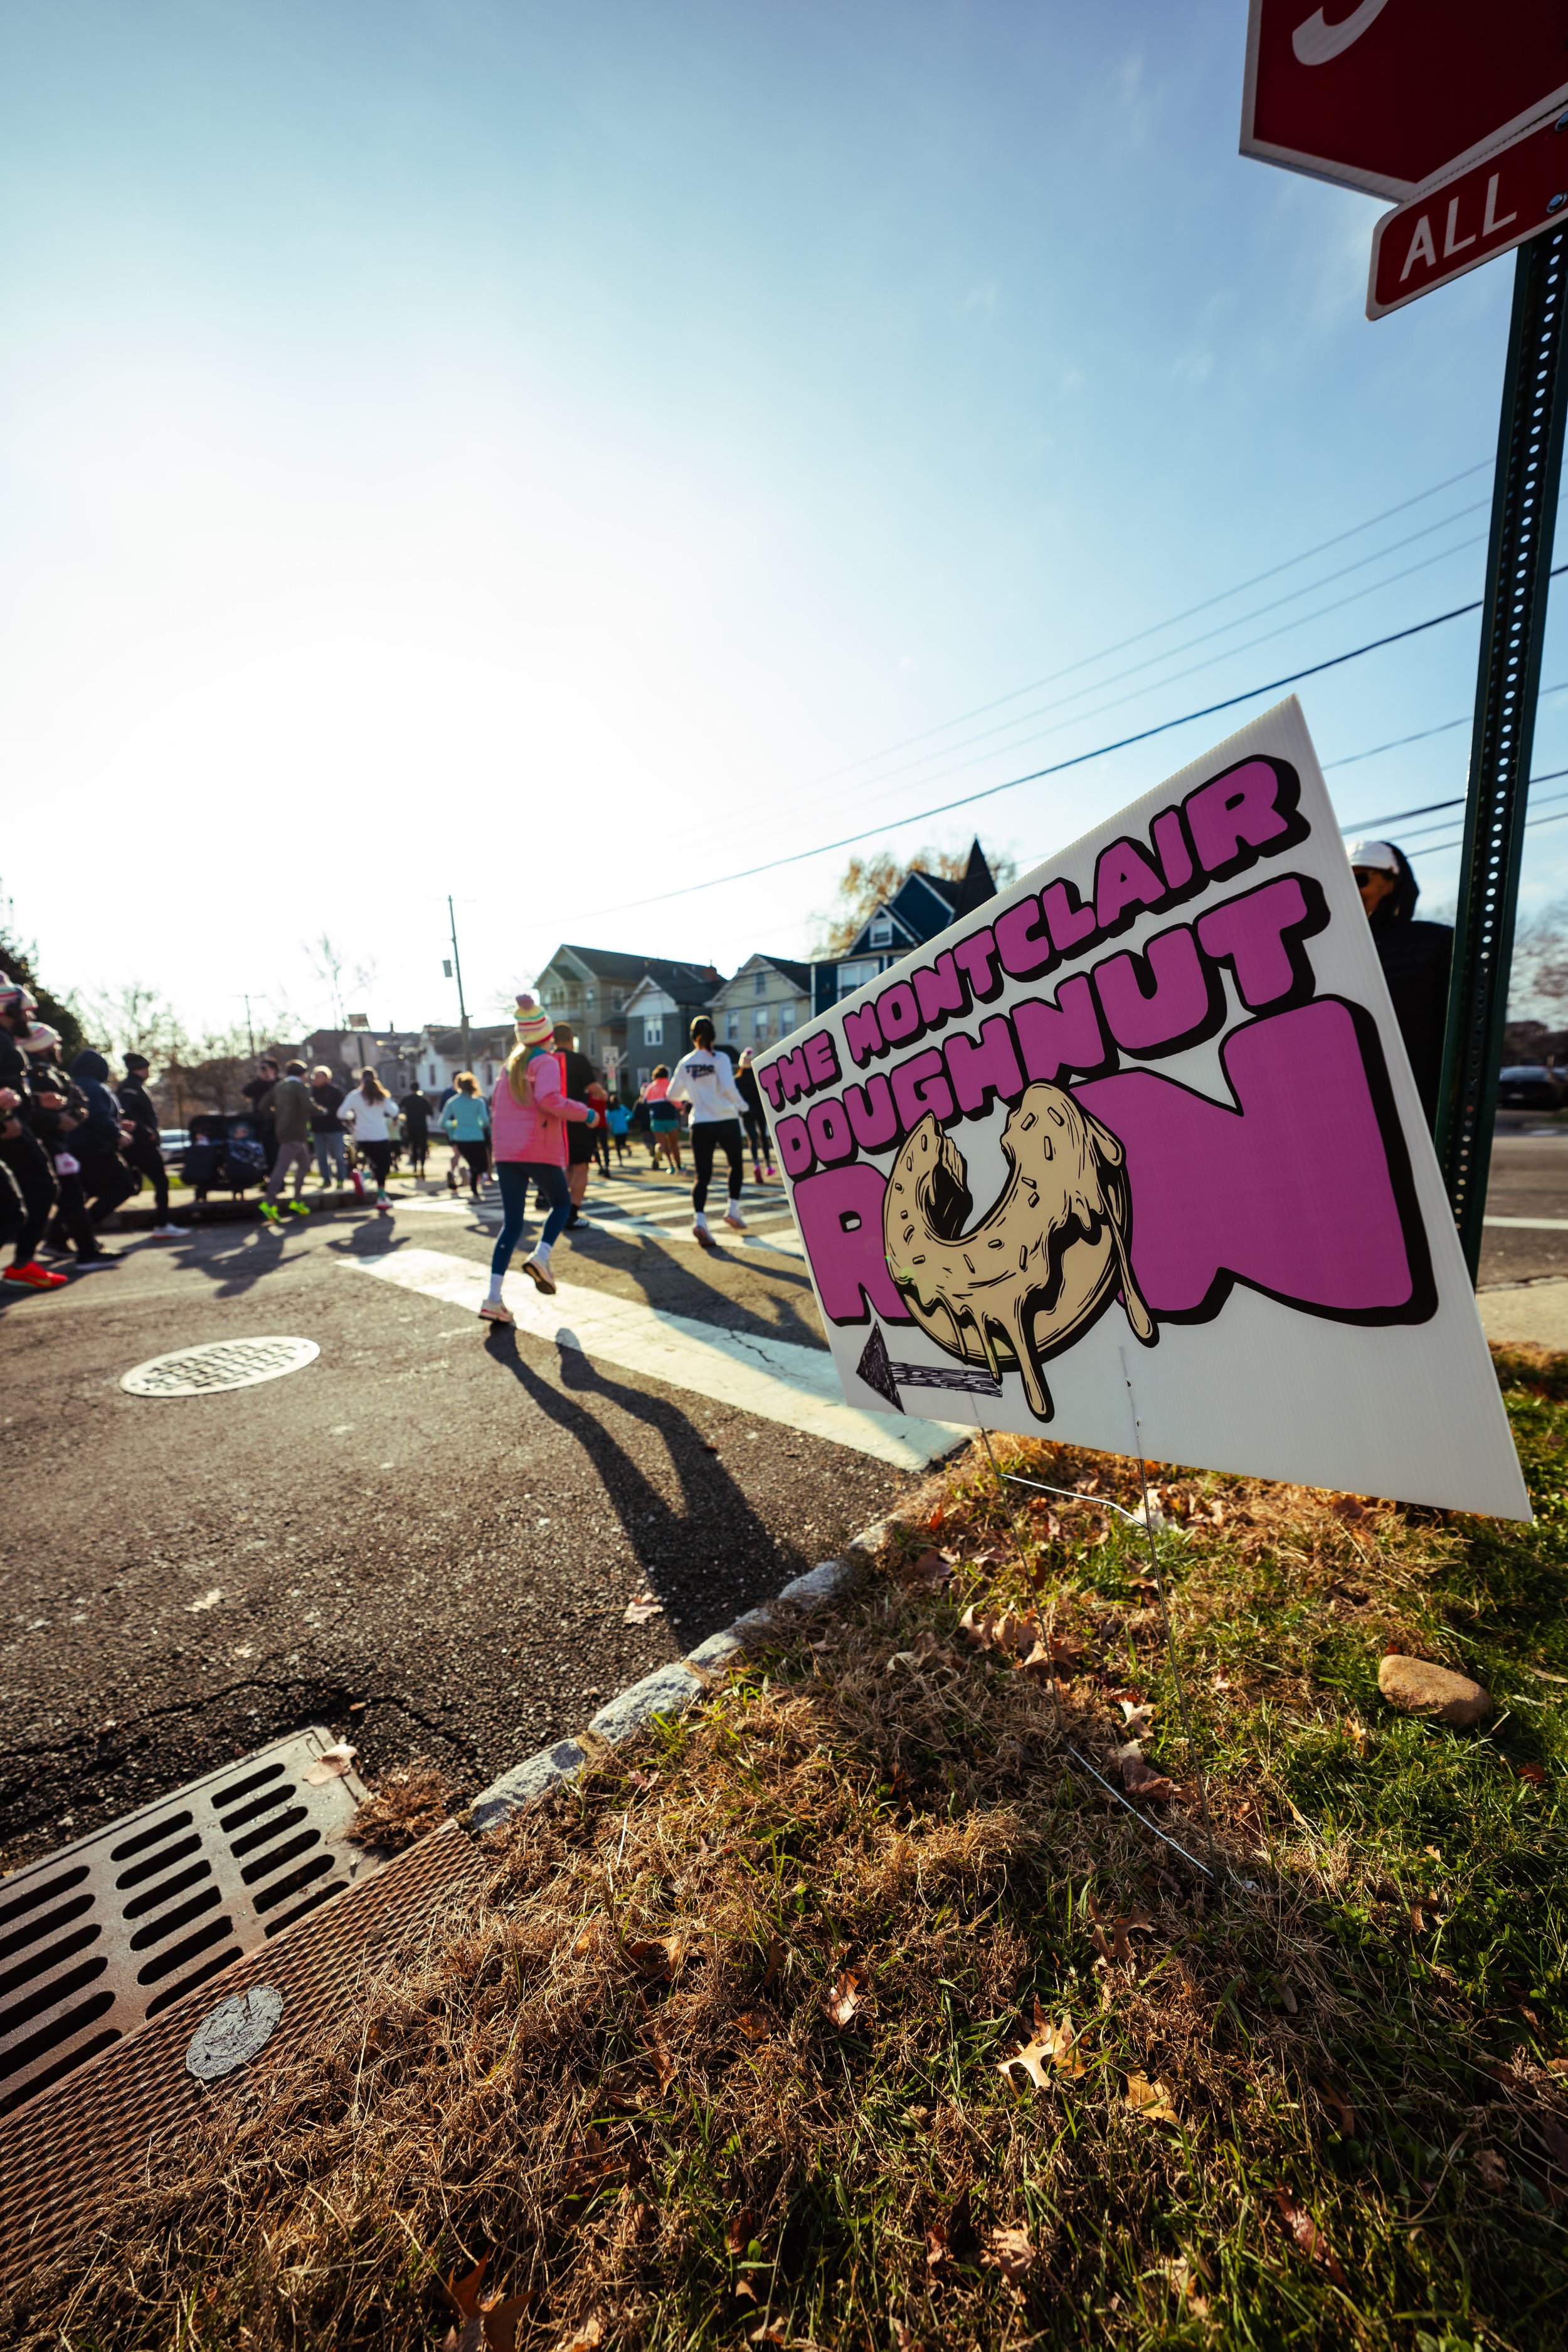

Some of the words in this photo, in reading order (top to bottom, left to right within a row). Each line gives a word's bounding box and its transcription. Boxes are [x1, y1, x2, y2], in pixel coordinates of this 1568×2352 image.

[1399, 172, 1517, 282] ALL
[758, 1029, 842, 1112] THE
[842, 754, 1311, 1069] MONTCLAIR
[775, 872, 1330, 1182] DOUGHNUT
